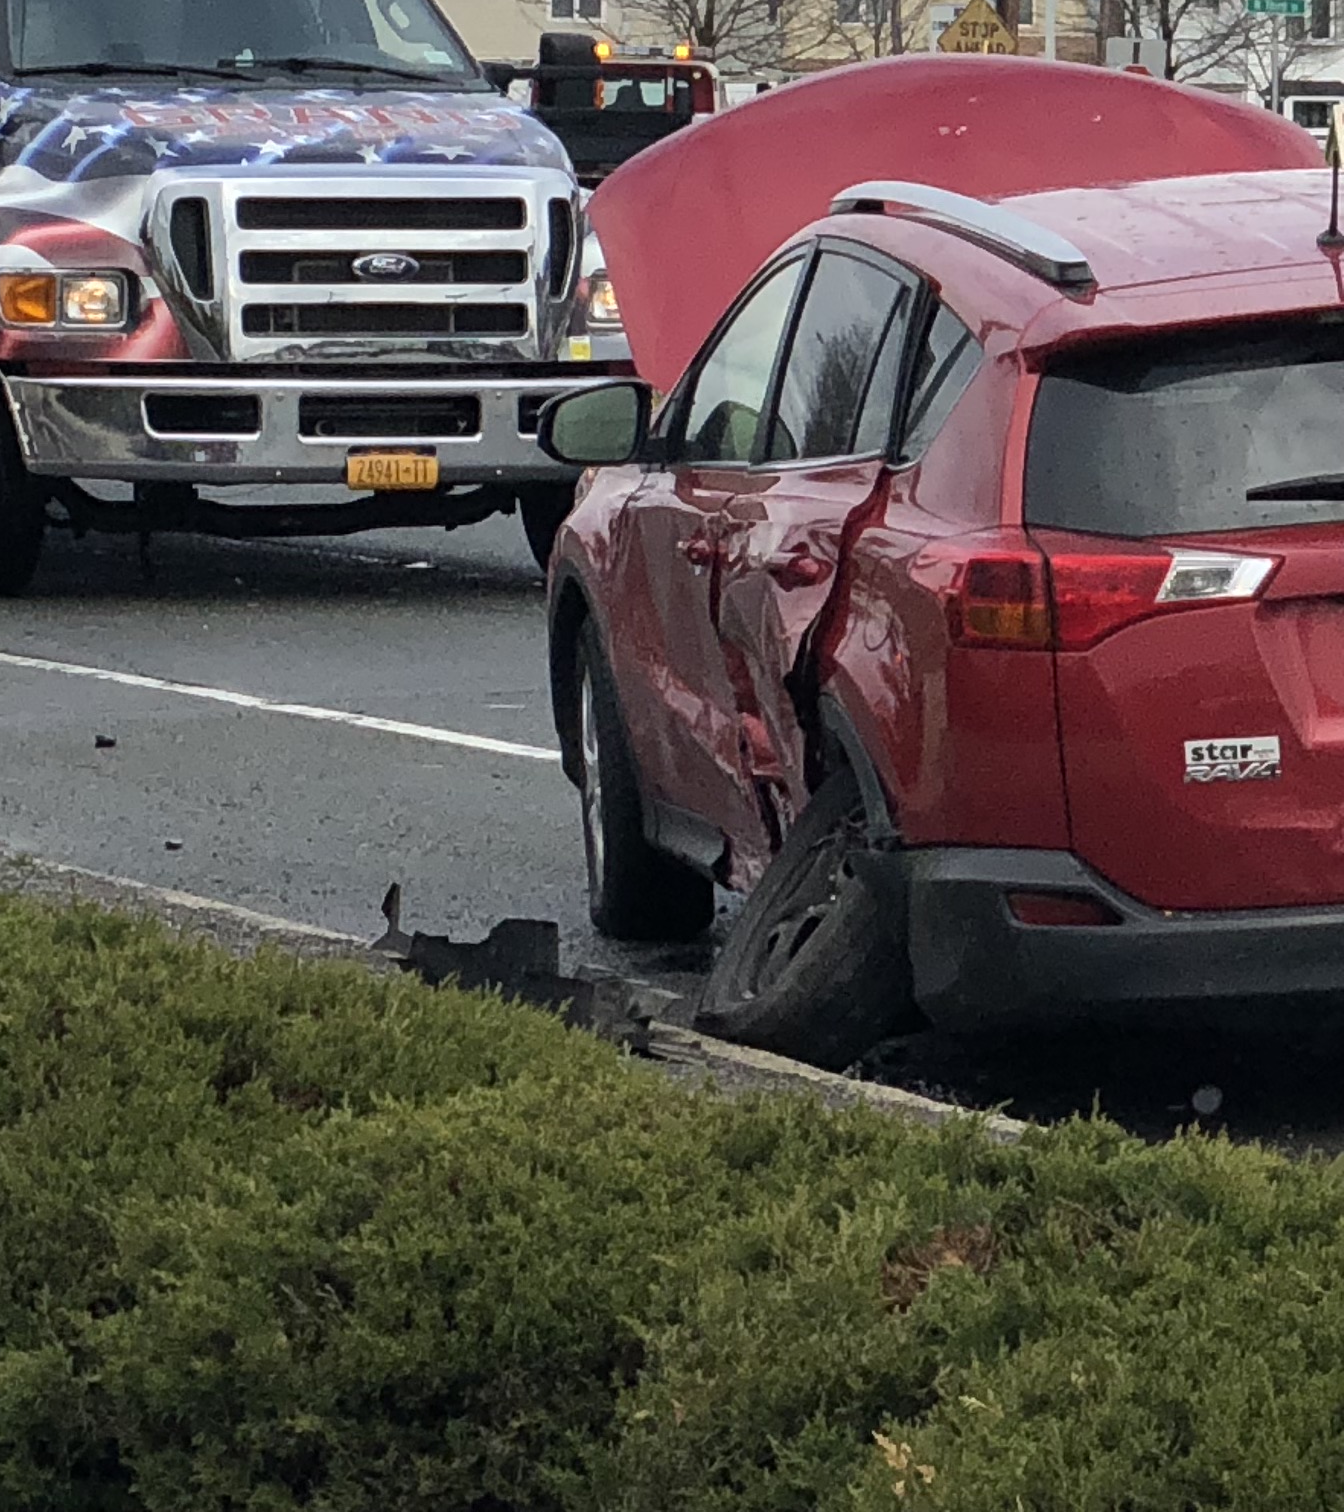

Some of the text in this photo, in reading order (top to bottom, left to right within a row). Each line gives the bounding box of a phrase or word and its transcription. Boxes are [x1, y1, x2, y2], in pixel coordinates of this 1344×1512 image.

[959, 22, 1000, 38] STOP
[356, 459, 430, 484] 24941-TT
[1191, 742, 1253, 761] star
